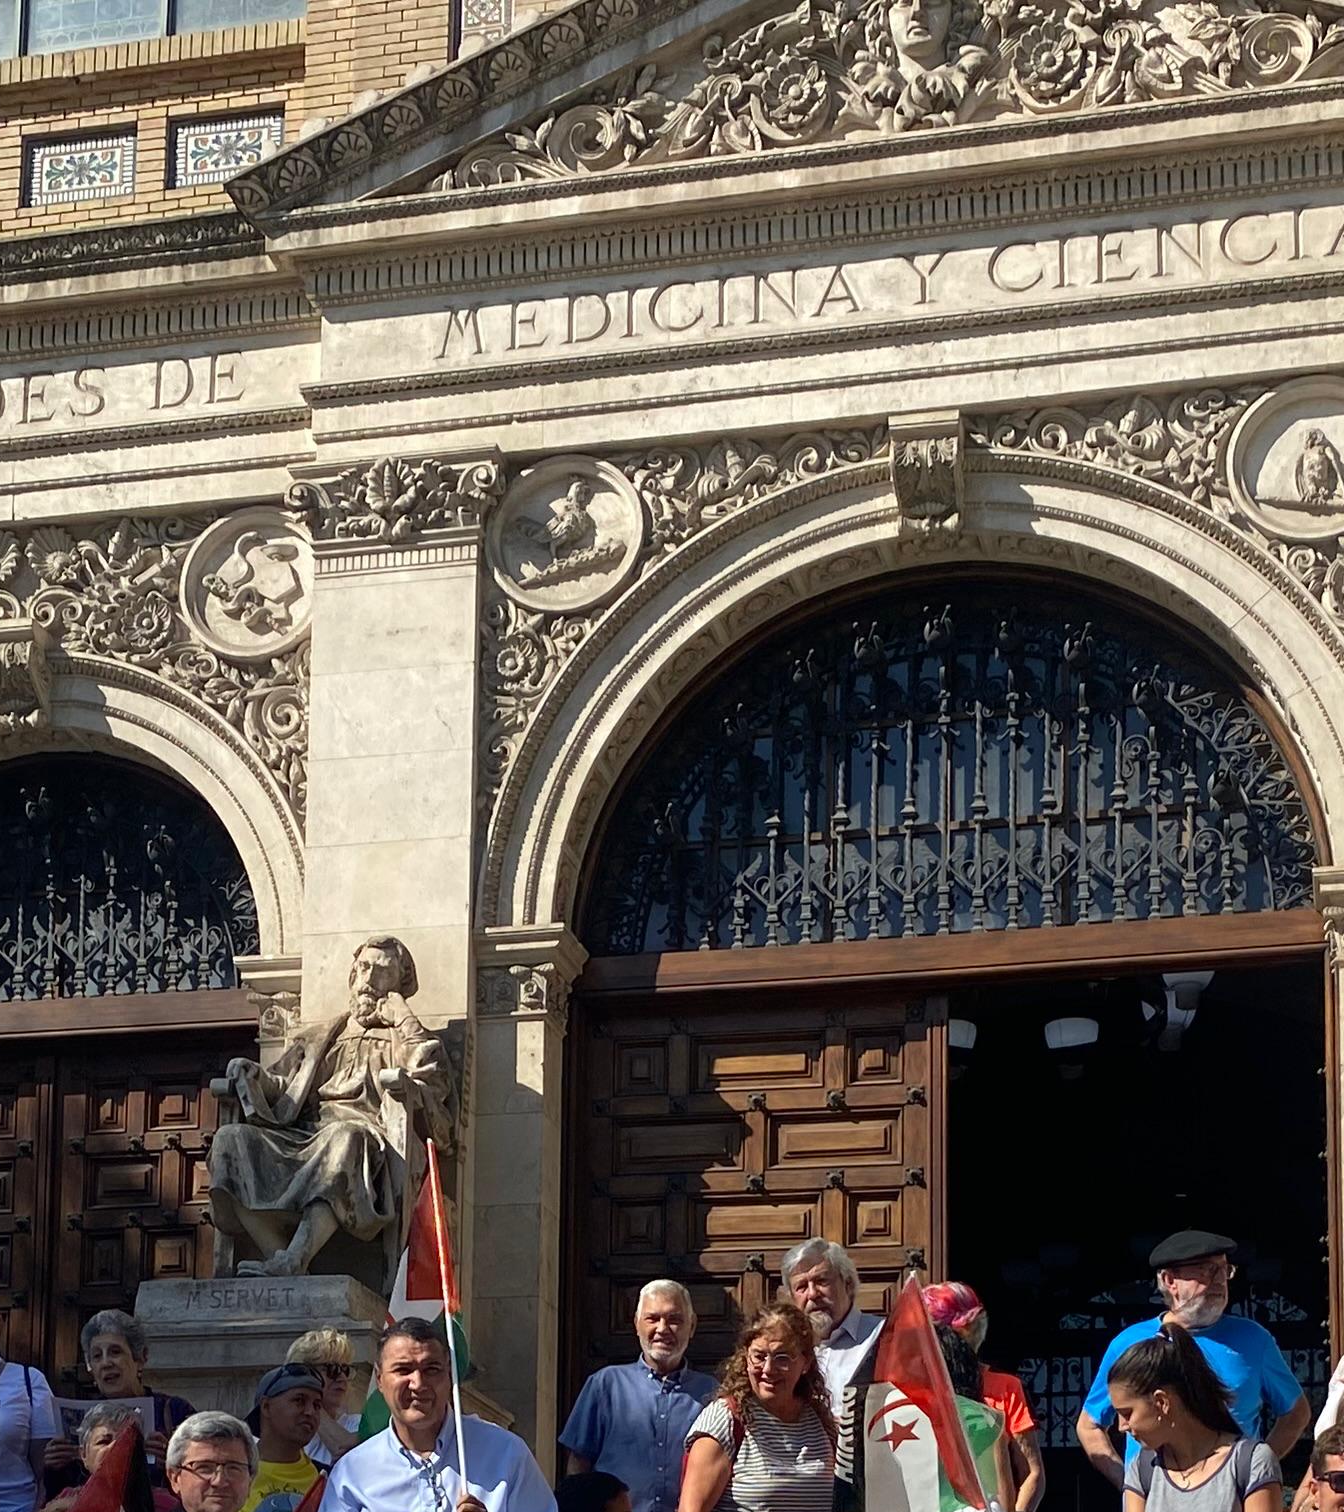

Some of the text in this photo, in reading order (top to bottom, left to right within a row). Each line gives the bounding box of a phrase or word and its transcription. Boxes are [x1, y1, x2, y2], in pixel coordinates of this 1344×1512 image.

[433, 264, 864, 360] MEDICINA
[900, 250, 952, 306] Y
[147, 348, 250, 410] DE
[210, 1286, 295, 1309] SERVET
